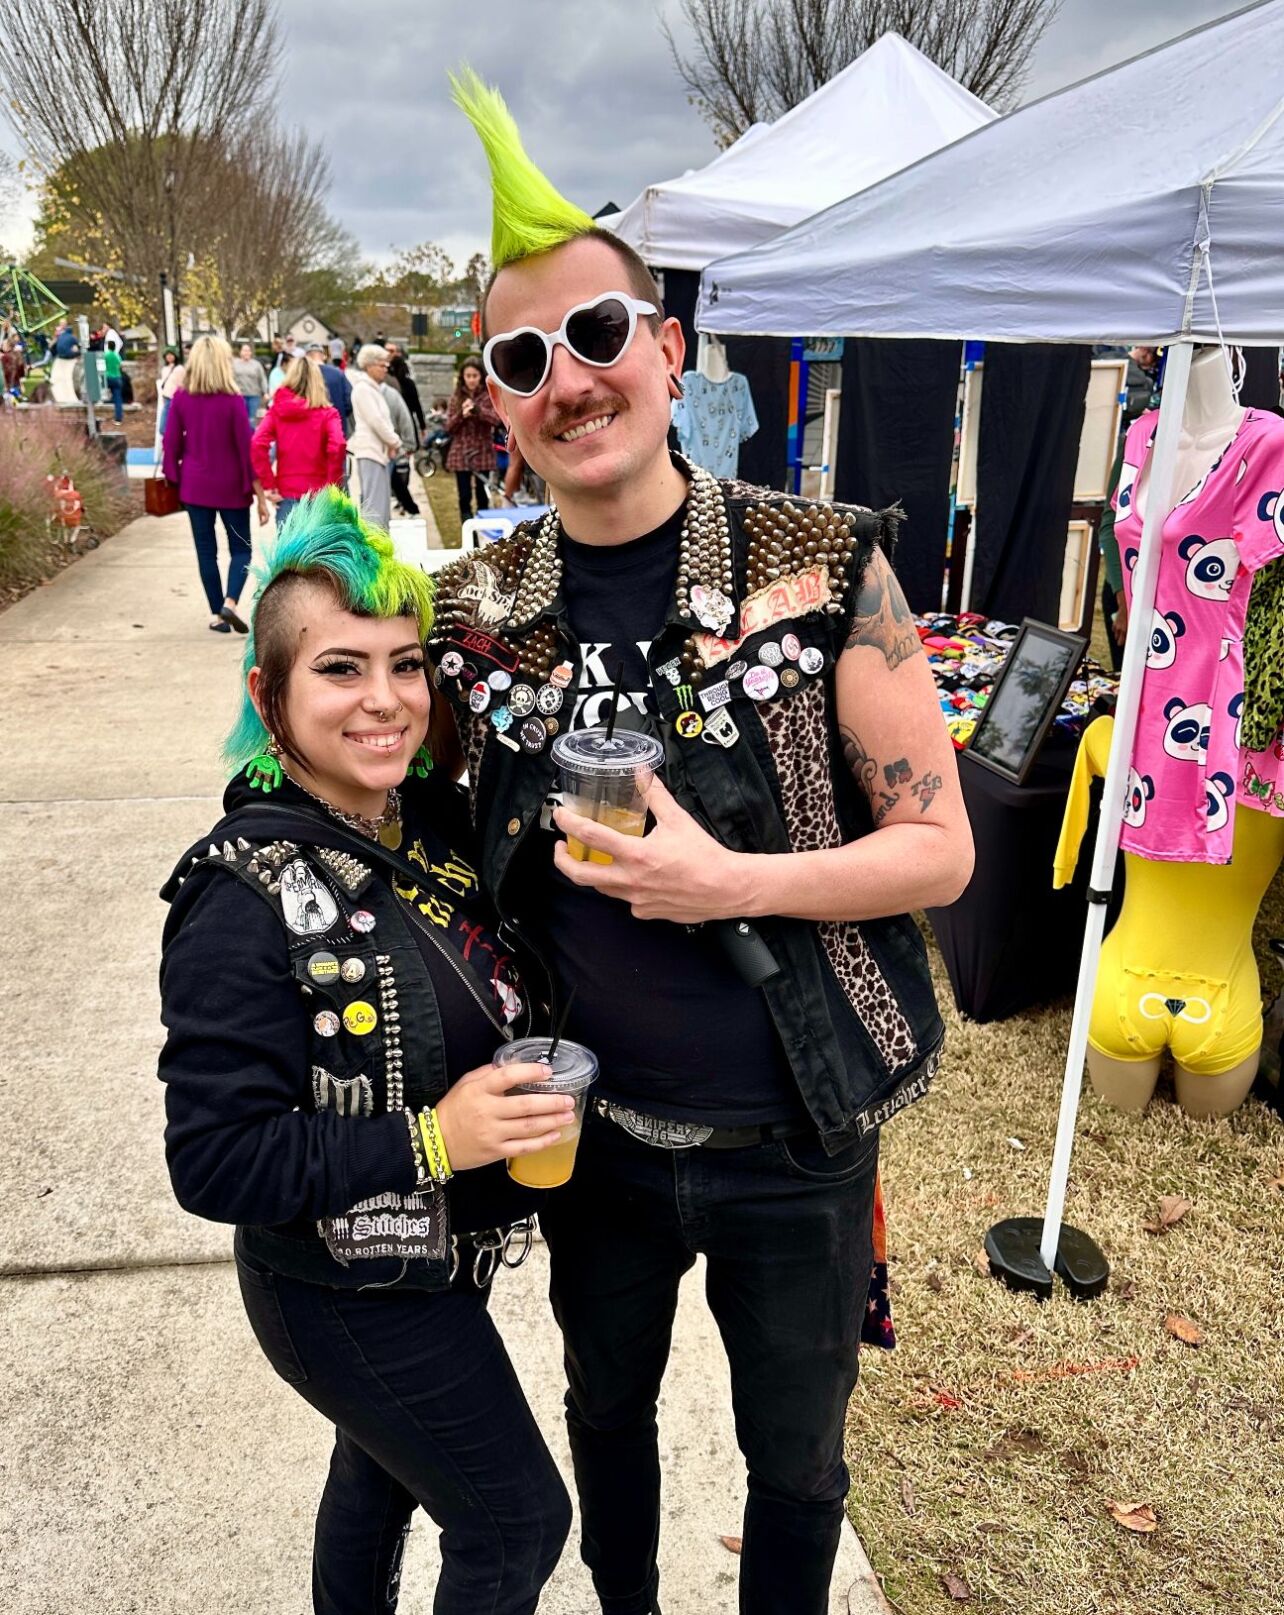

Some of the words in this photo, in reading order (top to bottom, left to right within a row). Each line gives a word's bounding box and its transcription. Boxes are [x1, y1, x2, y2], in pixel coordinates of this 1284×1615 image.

[462, 632, 492, 653] ZACH
[700, 681, 729, 699] THROUGH
[706, 689, 729, 703] BEING
[710, 696, 730, 707] COOL
[525, 740, 542, 749] TRUST
[911, 770, 943, 797] TCB
[355, 1243, 393, 1256] ROTTEN
[396, 1243, 428, 1255] YEARS
